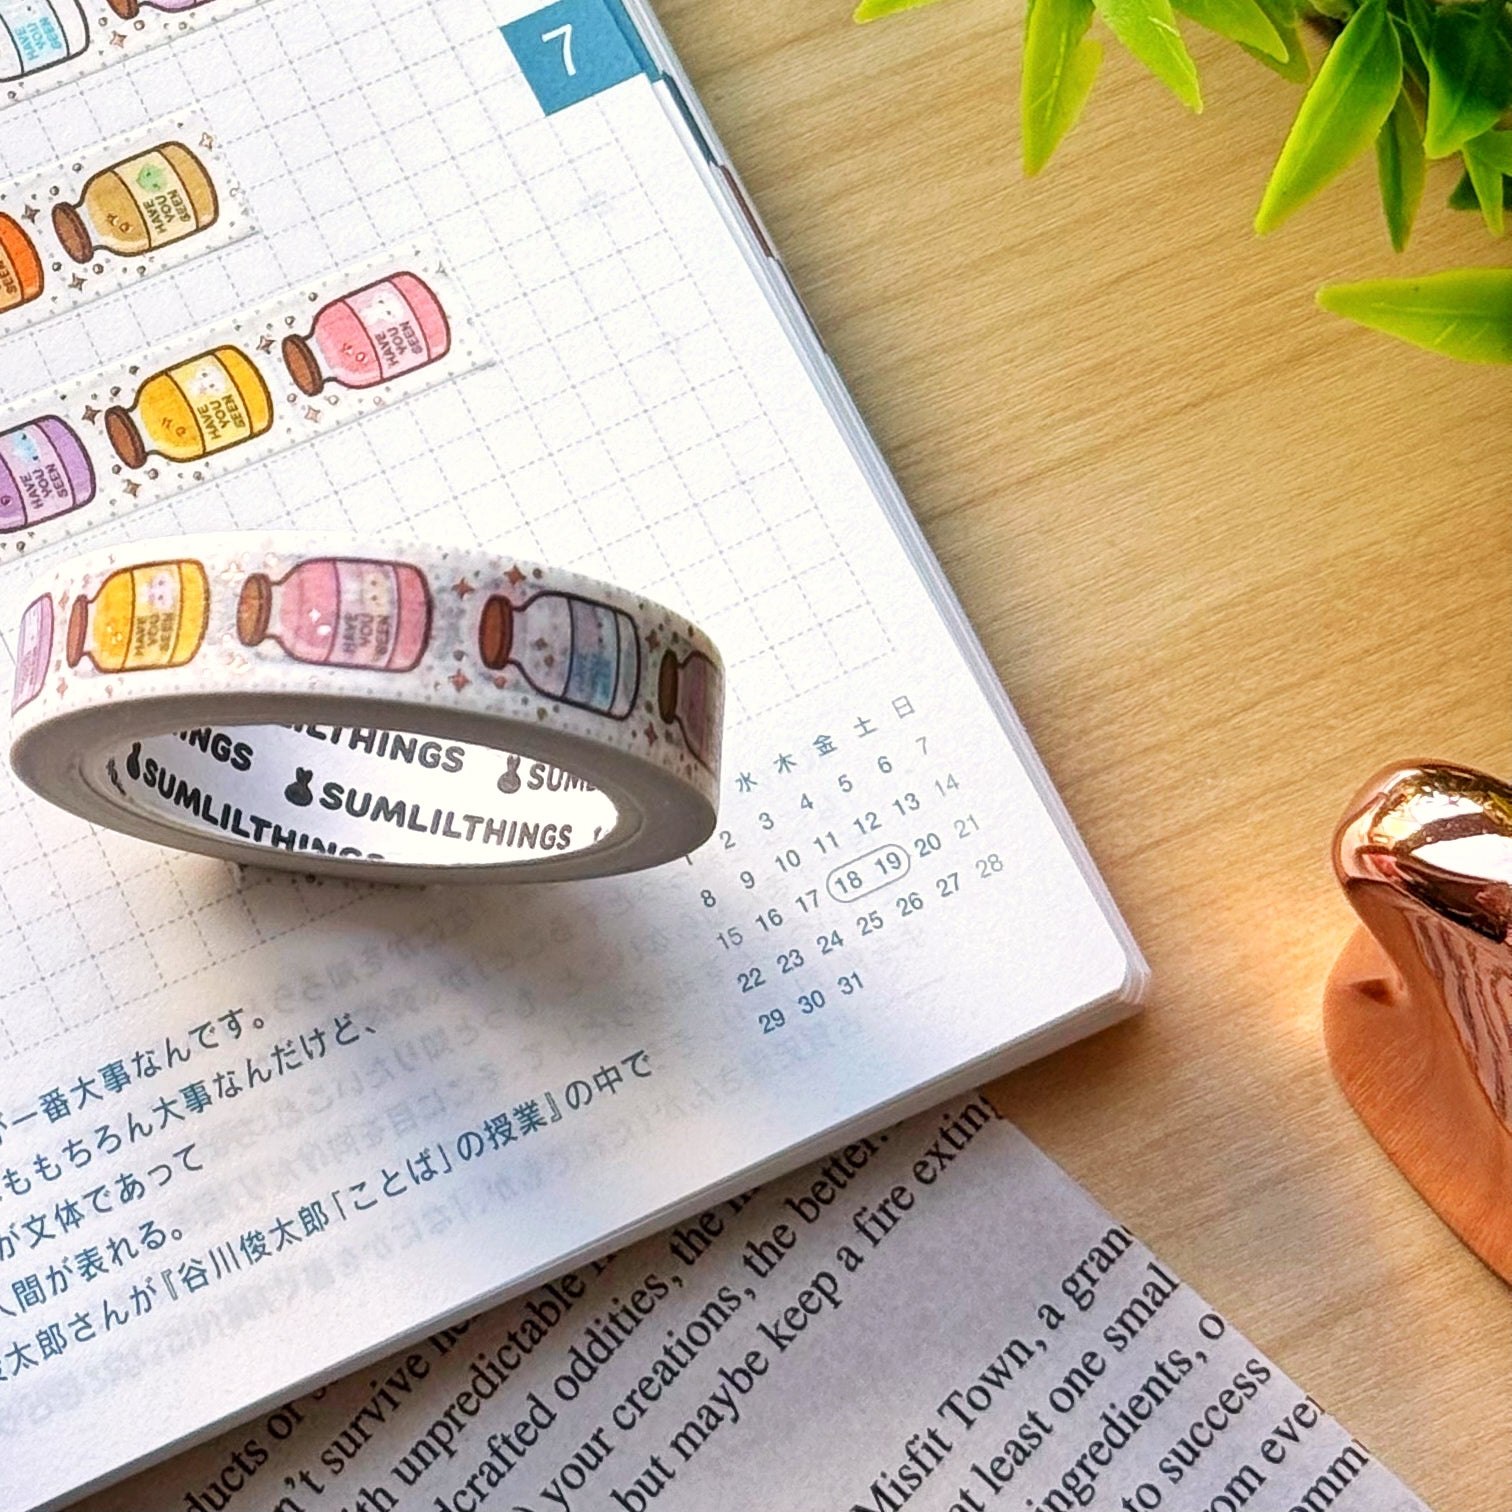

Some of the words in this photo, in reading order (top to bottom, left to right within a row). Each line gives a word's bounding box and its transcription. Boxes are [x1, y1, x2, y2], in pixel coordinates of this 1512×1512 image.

[541, 23, 577, 76] 7
[143, 199, 166, 233] HAVE
[155, 195, 176, 223] YOU
[375, 333, 399, 366] HAVE
[387, 327, 407, 355] YOU
[197, 405, 221, 440] HAVE
[210, 400, 229, 428] YOU
[20, 475, 43, 509] HAVE
[32, 469, 52, 497] YOU
[172, 727, 254, 771] NGS
[285, 726, 466, 773] LHINGS
[735, 771, 758, 792] 水
[773, 752, 797, 774] 木
[813, 734, 837, 756] 金
[854, 716, 877, 737] 土
[892, 696, 915, 718] 日
[142, 758, 385, 859] SUMLILTHIN
[319, 782, 573, 851] SUMLILTHINGS
[700, 889, 716, 908] 8
[740, 872, 755, 888] 9
[775, 850, 801, 873] 10
[814, 831, 840, 855] 11
[853, 812, 882, 835] 12
[892, 792, 920, 816] 13
[935, 773, 960, 797] 14
[719, 830, 736, 849] 2
[759, 813, 774, 830] 3
[800, 793, 813, 810] 4
[838, 774, 853, 792] 5
[877, 756, 892, 773] 6
[916, 737, 928, 755] 7
[716, 927, 744, 951] 15
[755, 909, 784, 932] 16
[795, 889, 820, 913] 17
[834, 870, 863, 894] 18
[875, 852, 902, 875] 19
[914, 833, 941, 857] 20
[954, 814, 980, 839] 21
[737, 968, 766, 993] 22
[776, 949, 805, 973] 23
[816, 930, 844, 955] 24
[856, 910, 884, 935] 25
[896, 892, 924, 916] 26
[936, 873, 961, 897] 27
[976, 854, 1004, 878] 28
[758, 1009, 786, 1034] 29
[798, 990, 825, 1014] 30
[838, 971, 864, 995] 31
[540, 1427, 615, 1512] your
[612, 1283, 757, 1430] creations,
[742, 1222, 797, 1280] the
[786, 1134, 890, 1224] better.
[553, 1271, 684, 1402] oddities,
[670, 1208, 725, 1266] the
[609, 1453, 676, 1512] but
[669, 1350, 769, 1462] maybe
[757, 1269, 842, 1353] keep
[837, 1244, 864, 1272] a
[853, 1184, 915, 1248] fire
[321, 1351, 431, 1476] survive
[391, 1270, 587, 1487] unpredictable
[849, 1427, 953, 1512] Misfit
[936, 1338, 1047, 1431] Town,
[1037, 1302, 1066, 1330] a
[1060, 1225, 1134, 1311] gran
[970, 1410, 1053, 1495] least
[1048, 1350, 1107, 1413] one
[1158, 1358, 1271, 1484] success
